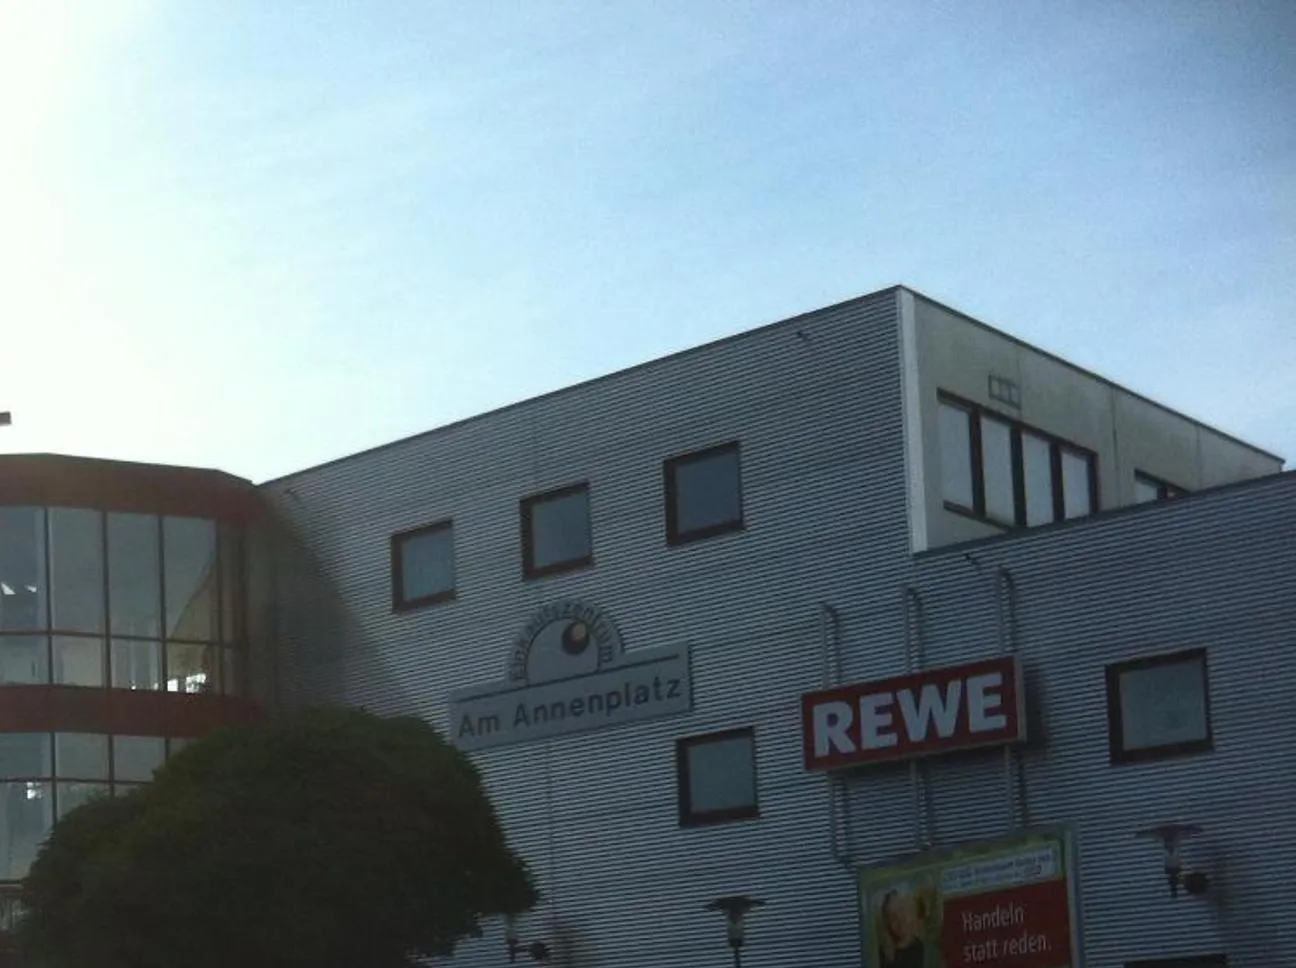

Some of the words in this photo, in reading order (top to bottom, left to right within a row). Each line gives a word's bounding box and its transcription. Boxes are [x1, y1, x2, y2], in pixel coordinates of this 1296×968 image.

[458, 714, 502, 740] Am
[513, 674, 683, 728] Annenplatz
[812, 671, 1008, 758] REWE
[960, 902, 1025, 933] Handeln
[962, 937, 999, 964] statt
[1003, 929, 1053, 957] reden.
